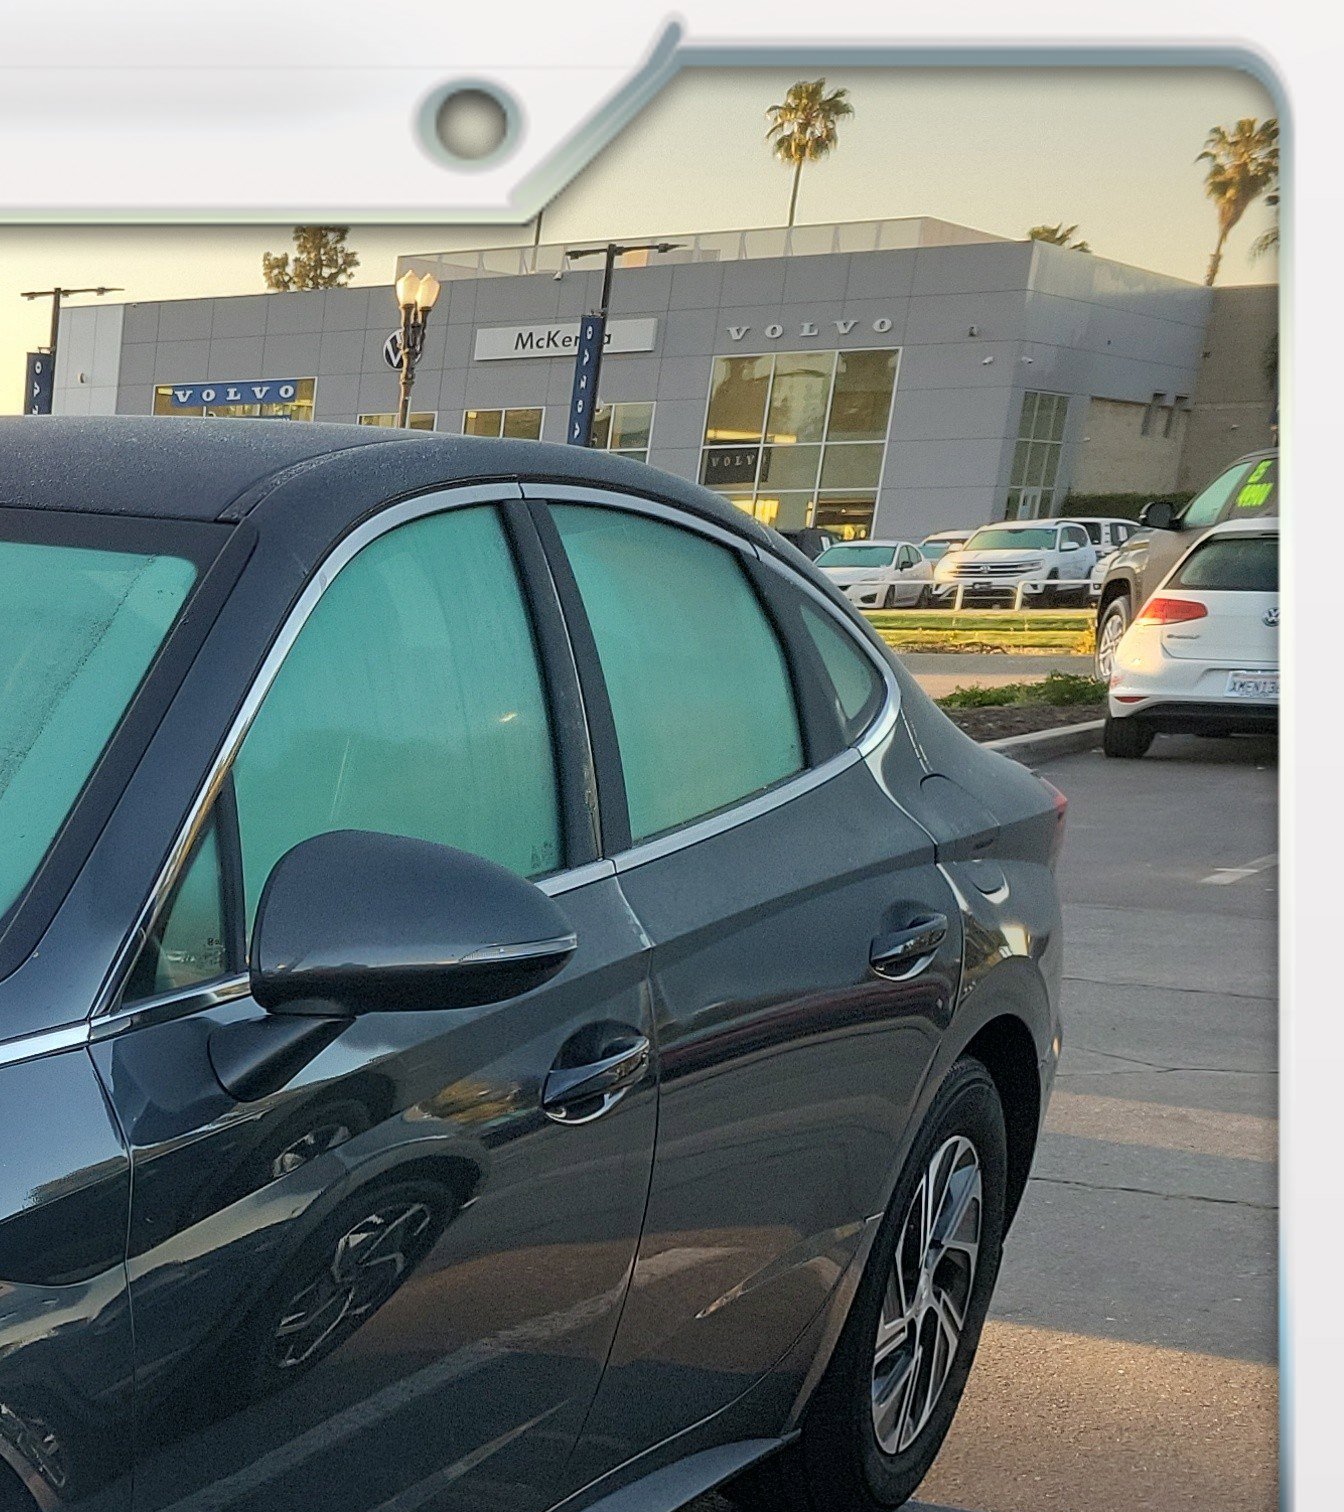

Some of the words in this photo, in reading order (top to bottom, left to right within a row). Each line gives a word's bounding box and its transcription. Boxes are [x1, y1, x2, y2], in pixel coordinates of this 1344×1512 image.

[514, 329, 612, 350] McKea
[727, 318, 893, 340] VOLVO
[32, 361, 42, 414] LVO
[573, 325, 593, 439] VOLVO
[174, 385, 295, 403] VOLVO
